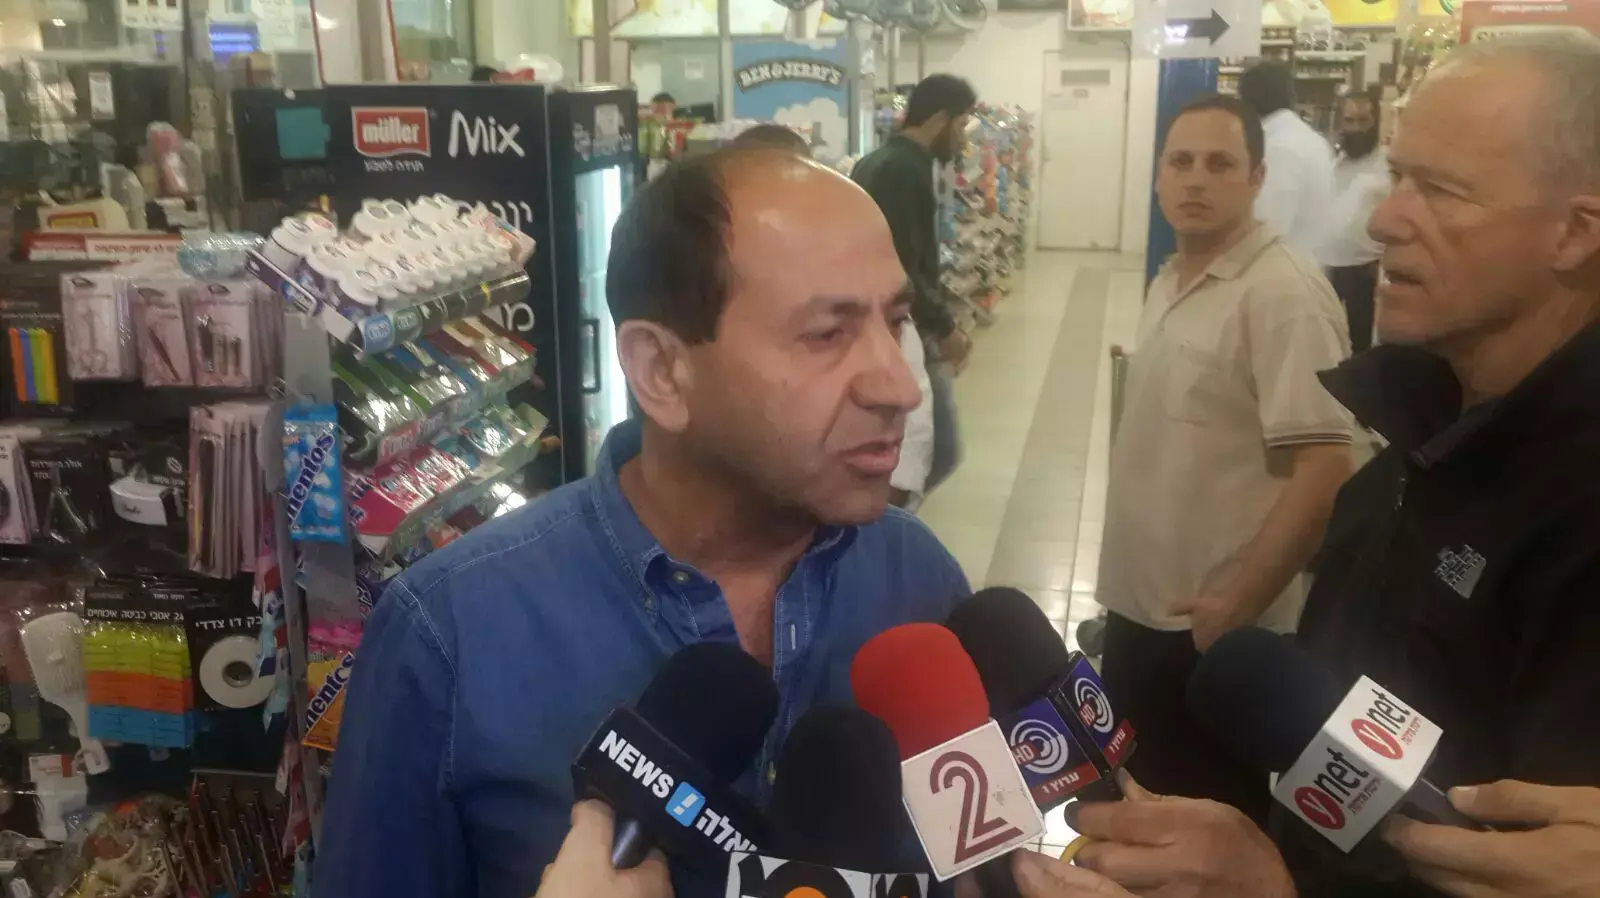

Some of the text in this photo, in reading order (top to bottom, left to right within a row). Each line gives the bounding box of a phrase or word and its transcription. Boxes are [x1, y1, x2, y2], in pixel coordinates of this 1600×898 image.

[739, 64, 771, 87] BEN
[361, 109, 526, 158] müller Mix
[286, 432, 336, 527] mentos
[195, 619, 227, 631] צדדי
[1079, 702, 1096, 726] HD
[1350, 688, 1411, 761] ynet
[598, 729, 675, 799] NEWS
[1012, 744, 1035, 765] HD
[1049, 772, 1080, 792] ערוץ
[1293, 747, 1369, 831] ynet
[929, 750, 1025, 865] 2
